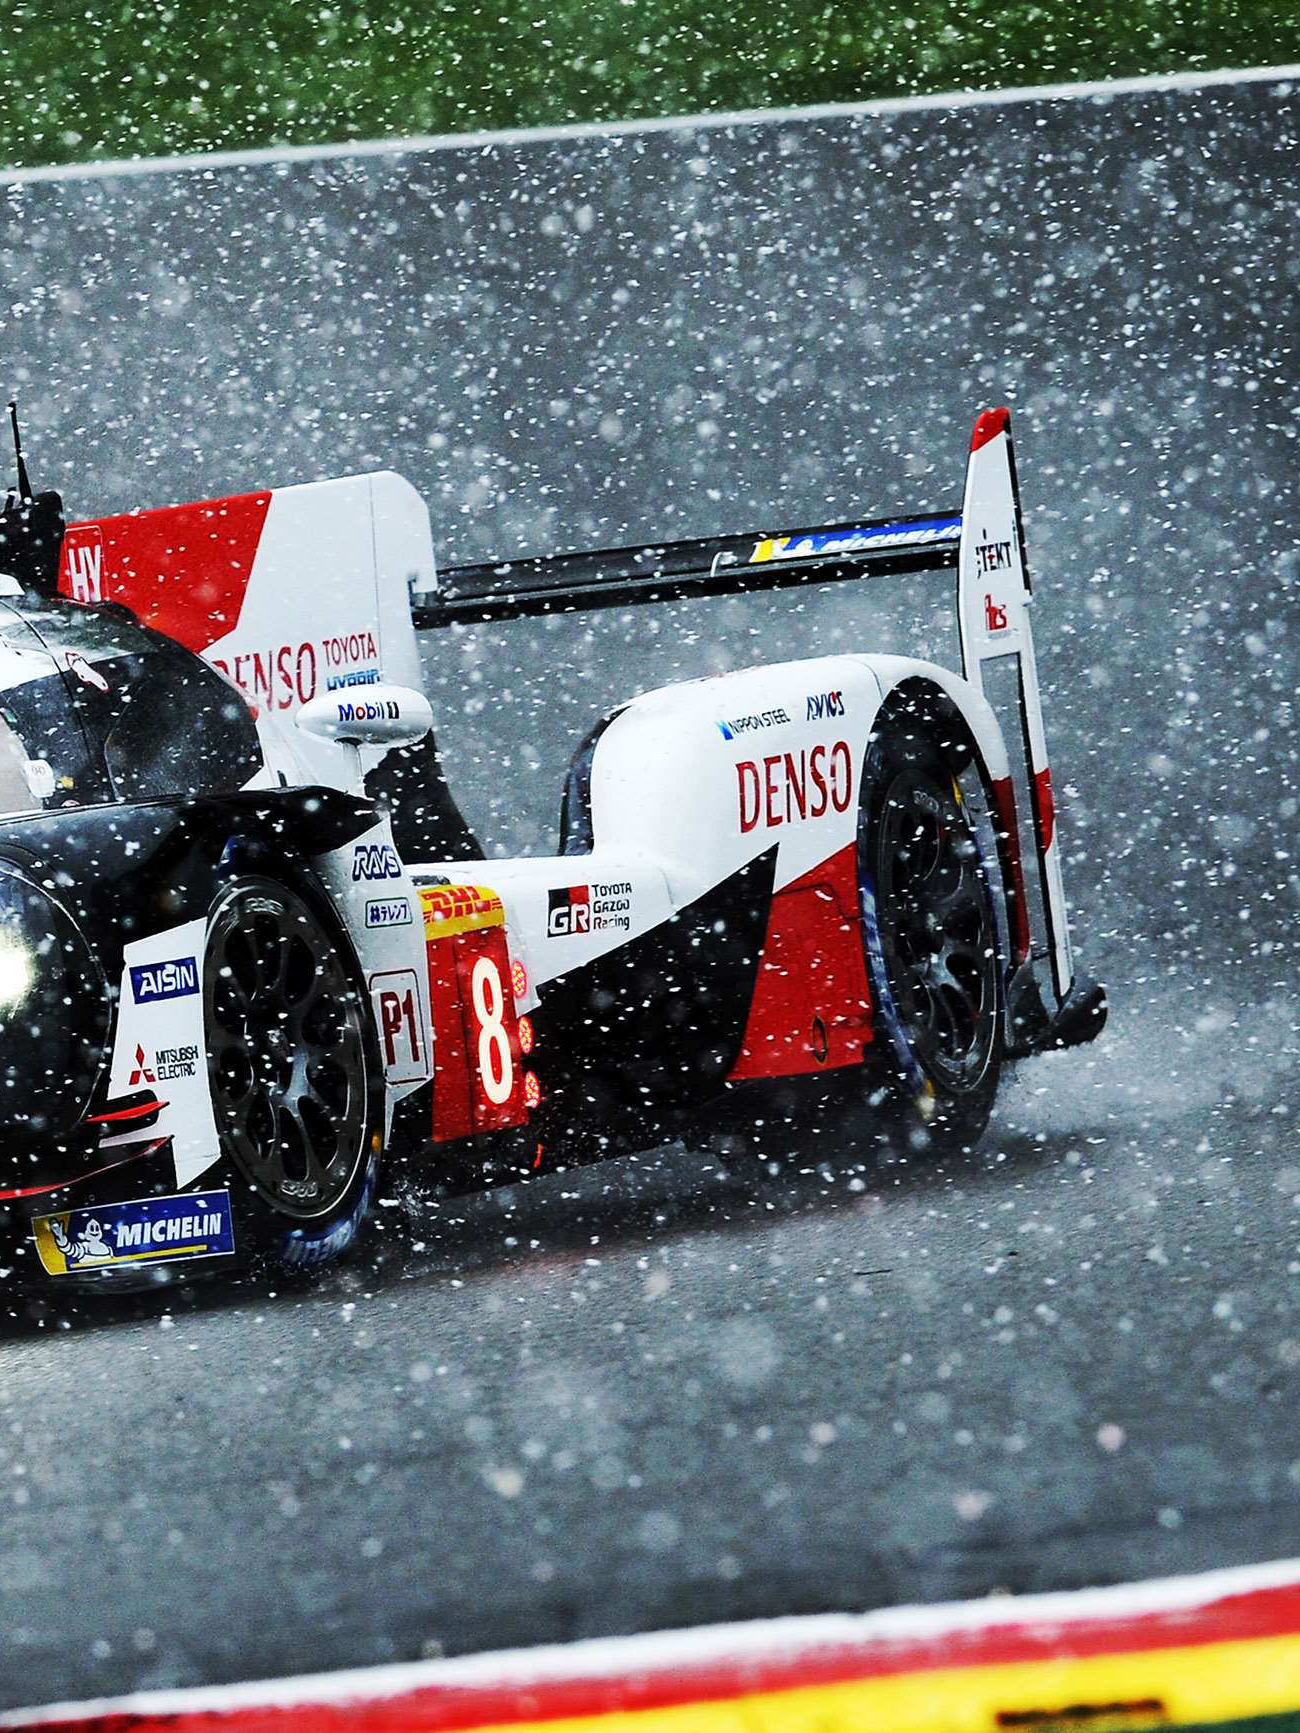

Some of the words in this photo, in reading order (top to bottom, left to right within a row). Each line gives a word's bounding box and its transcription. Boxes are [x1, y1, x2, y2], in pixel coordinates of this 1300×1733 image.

[322, 632, 377, 667] TOYOTA
[338, 703, 385, 722] Mobil
[727, 714, 765, 734] NIPPON
[761, 708, 791, 727] STEEL
[735, 740, 852, 834] DENSO
[352, 845, 402, 881] RAYS
[591, 882, 633, 898] TOYOTA
[593, 899, 630, 914] GAZOO
[548, 903, 589, 935] GR
[593, 914, 631, 931] Racing
[139, 962, 196, 996] AISIN
[379, 989, 421, 1065] P1
[472, 957, 513, 1104] 8
[157, 1061, 197, 1081] ELECTRIC
[116, 1212, 222, 1248] MICHELIN
